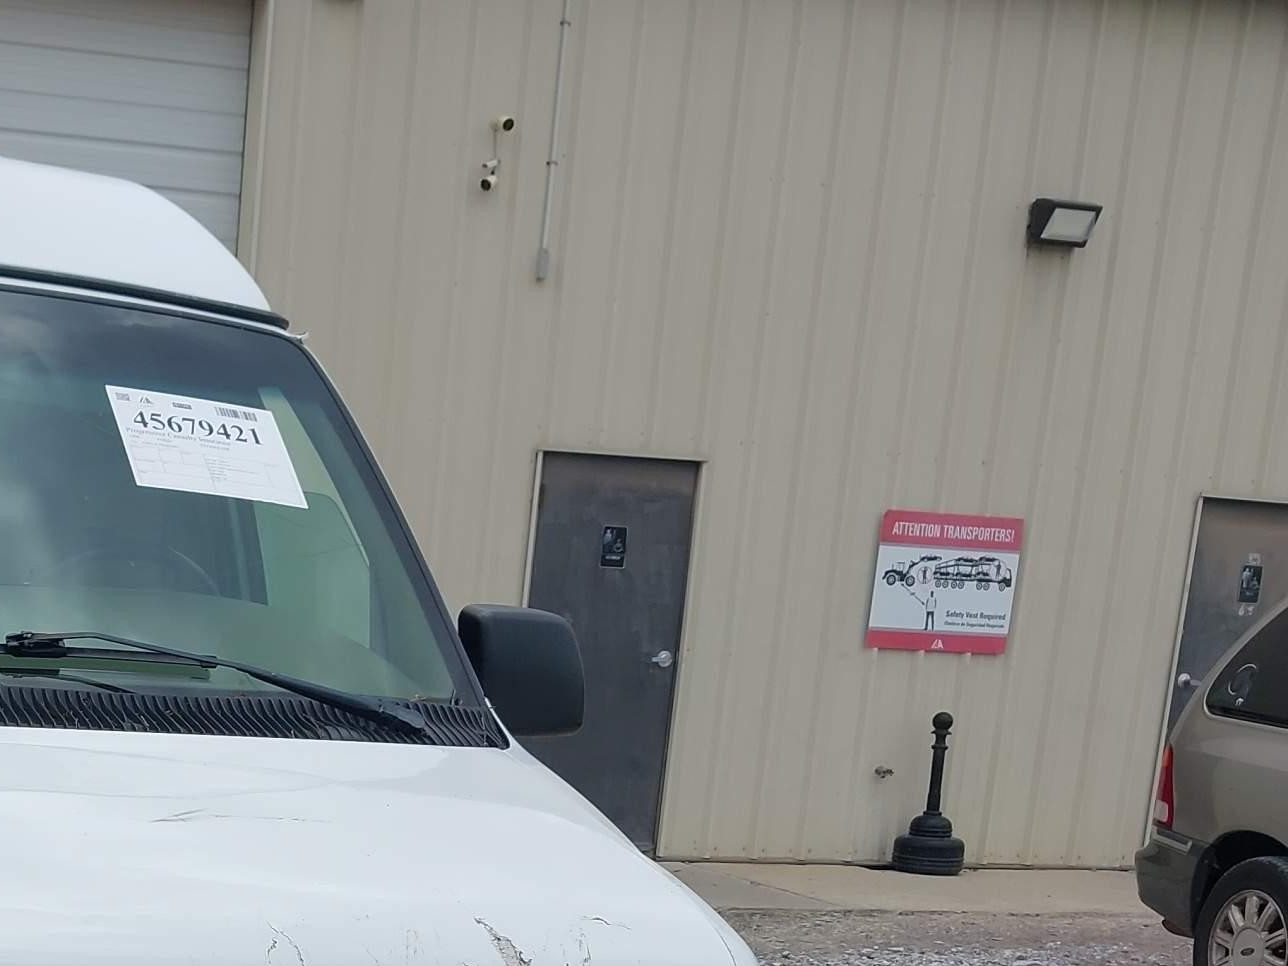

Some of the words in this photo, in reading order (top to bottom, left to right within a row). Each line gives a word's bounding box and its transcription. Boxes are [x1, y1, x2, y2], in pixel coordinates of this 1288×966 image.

[132, 410, 263, 445] 45679421
[892, 521, 941, 538] ATTENTION
[943, 525, 1015, 543] TRANSPORTERS!
